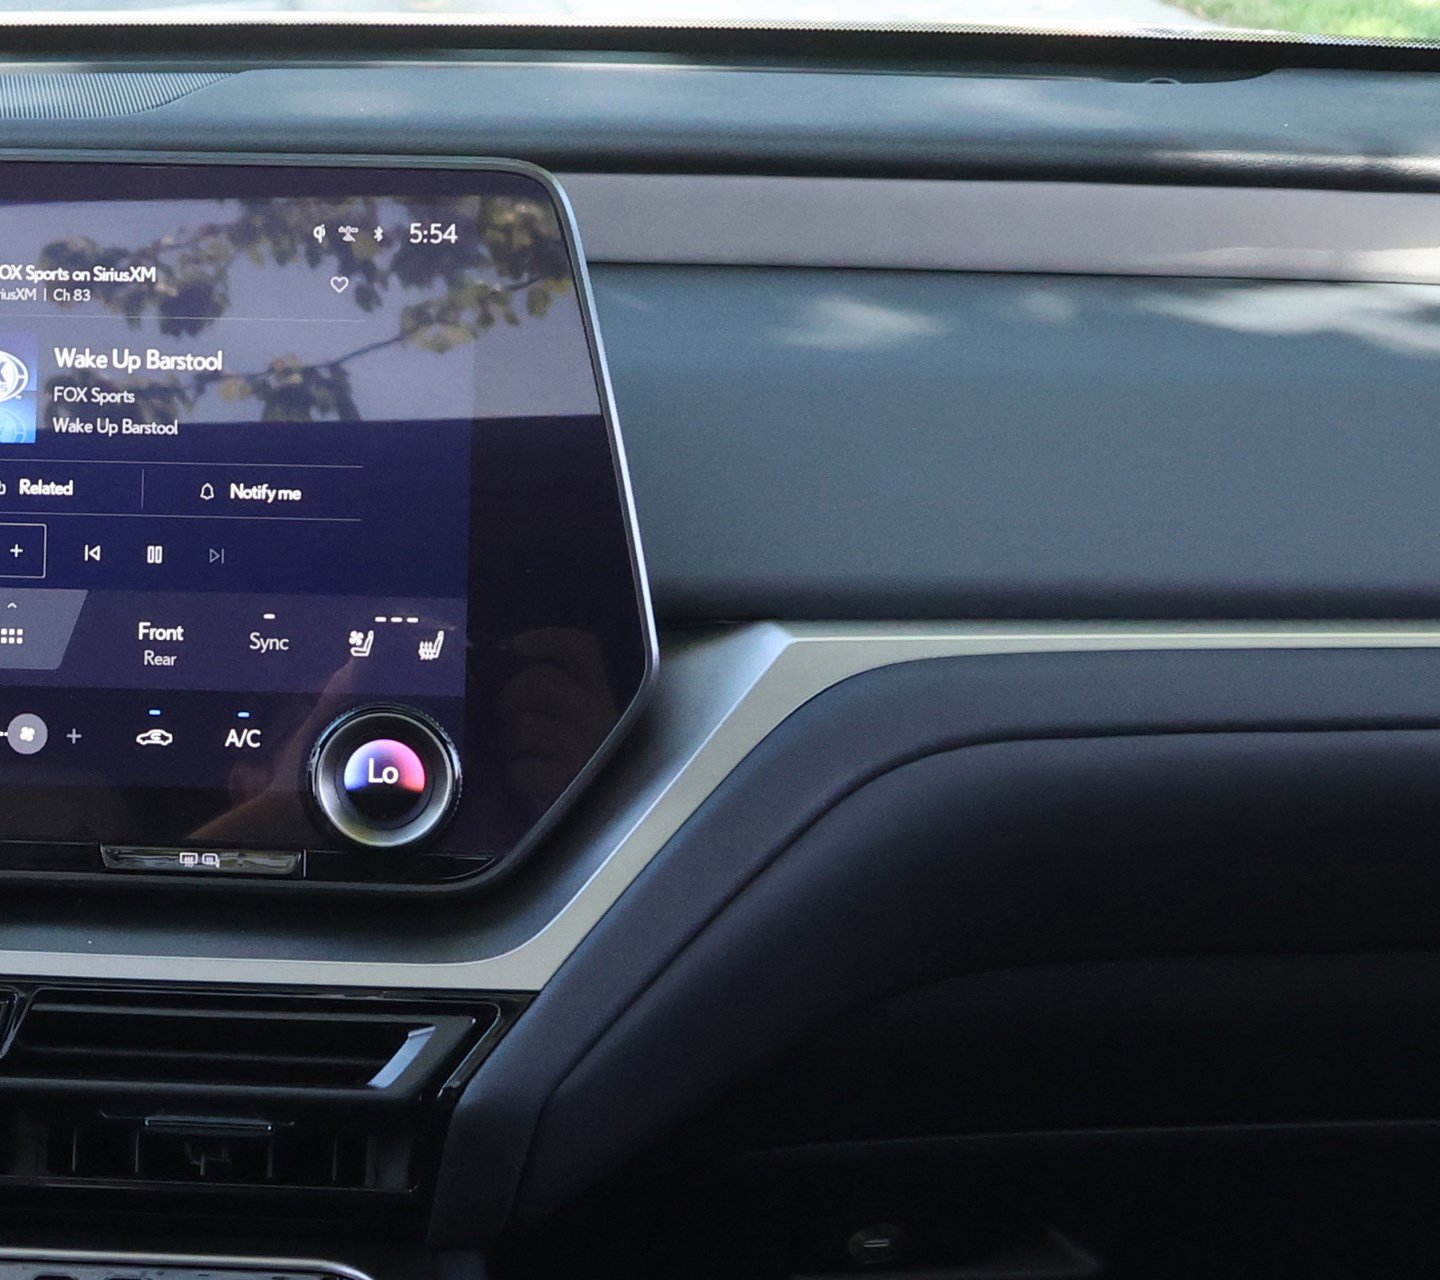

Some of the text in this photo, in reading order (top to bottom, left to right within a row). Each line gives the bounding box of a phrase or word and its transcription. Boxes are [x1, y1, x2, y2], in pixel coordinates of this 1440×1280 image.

[409, 223, 458, 245] 5:54
[25, 265, 69, 285] Sports
[72, 269, 90, 283] on
[93, 266, 157, 284] SiriusXM
[53, 288, 71, 302] Ch
[73, 288, 91, 303] 83
[54, 348, 223, 374] Wake Up Barstool
[54, 388, 135, 407] FOX Sports
[53, 418, 179, 438] Wake Up Barstool
[19, 479, 73, 497] Related
[230, 483, 302, 503] Notify me
[138, 622, 184, 643] Front
[249, 633, 289, 655] Sync
[144, 651, 177, 668] Rear
[224, 727, 261, 750] A/C
[368, 759, 399, 785] Lo
